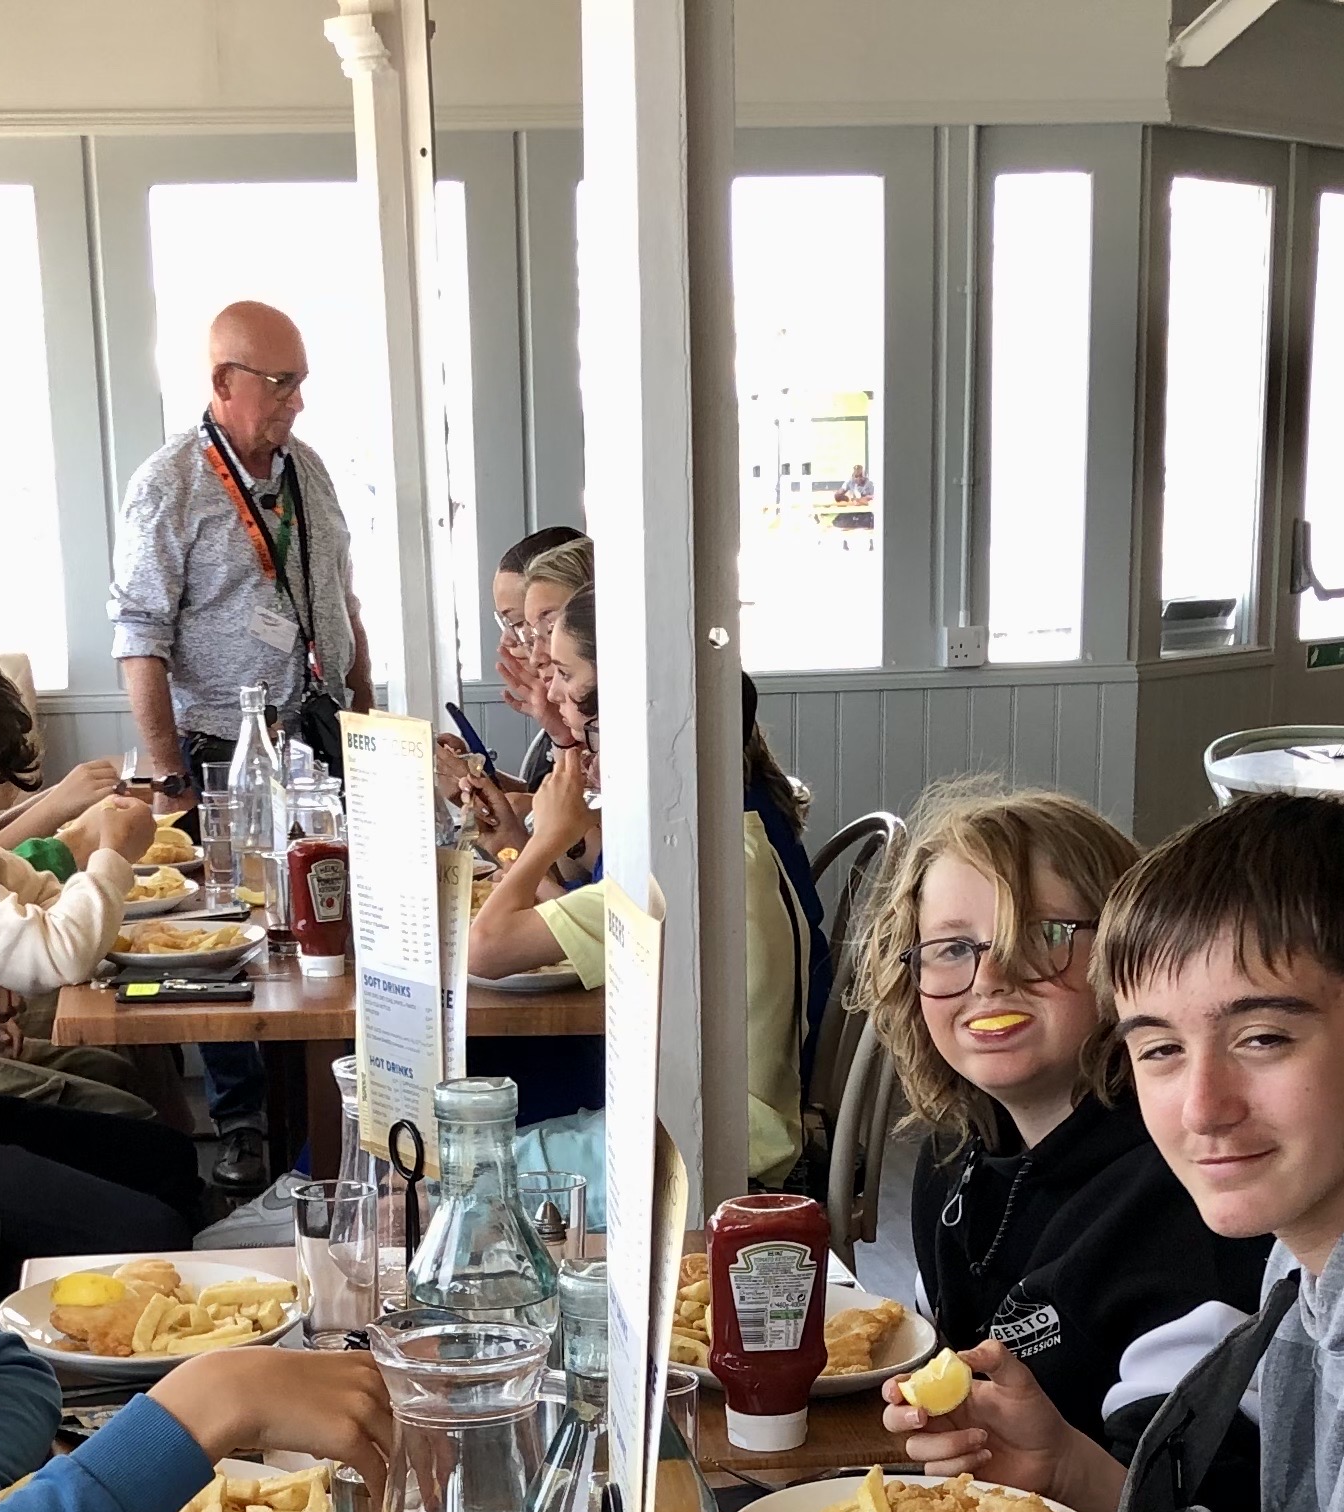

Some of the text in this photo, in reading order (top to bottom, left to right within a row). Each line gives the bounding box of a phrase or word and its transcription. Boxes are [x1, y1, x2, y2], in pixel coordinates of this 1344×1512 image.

[347, 732, 377, 752] BEERS
[363, 974, 412, 998] SOFT DRINKS
[369, 1055, 414, 1080] HOT DRINKS
[1020, 1335, 1061, 1358] SESSION
